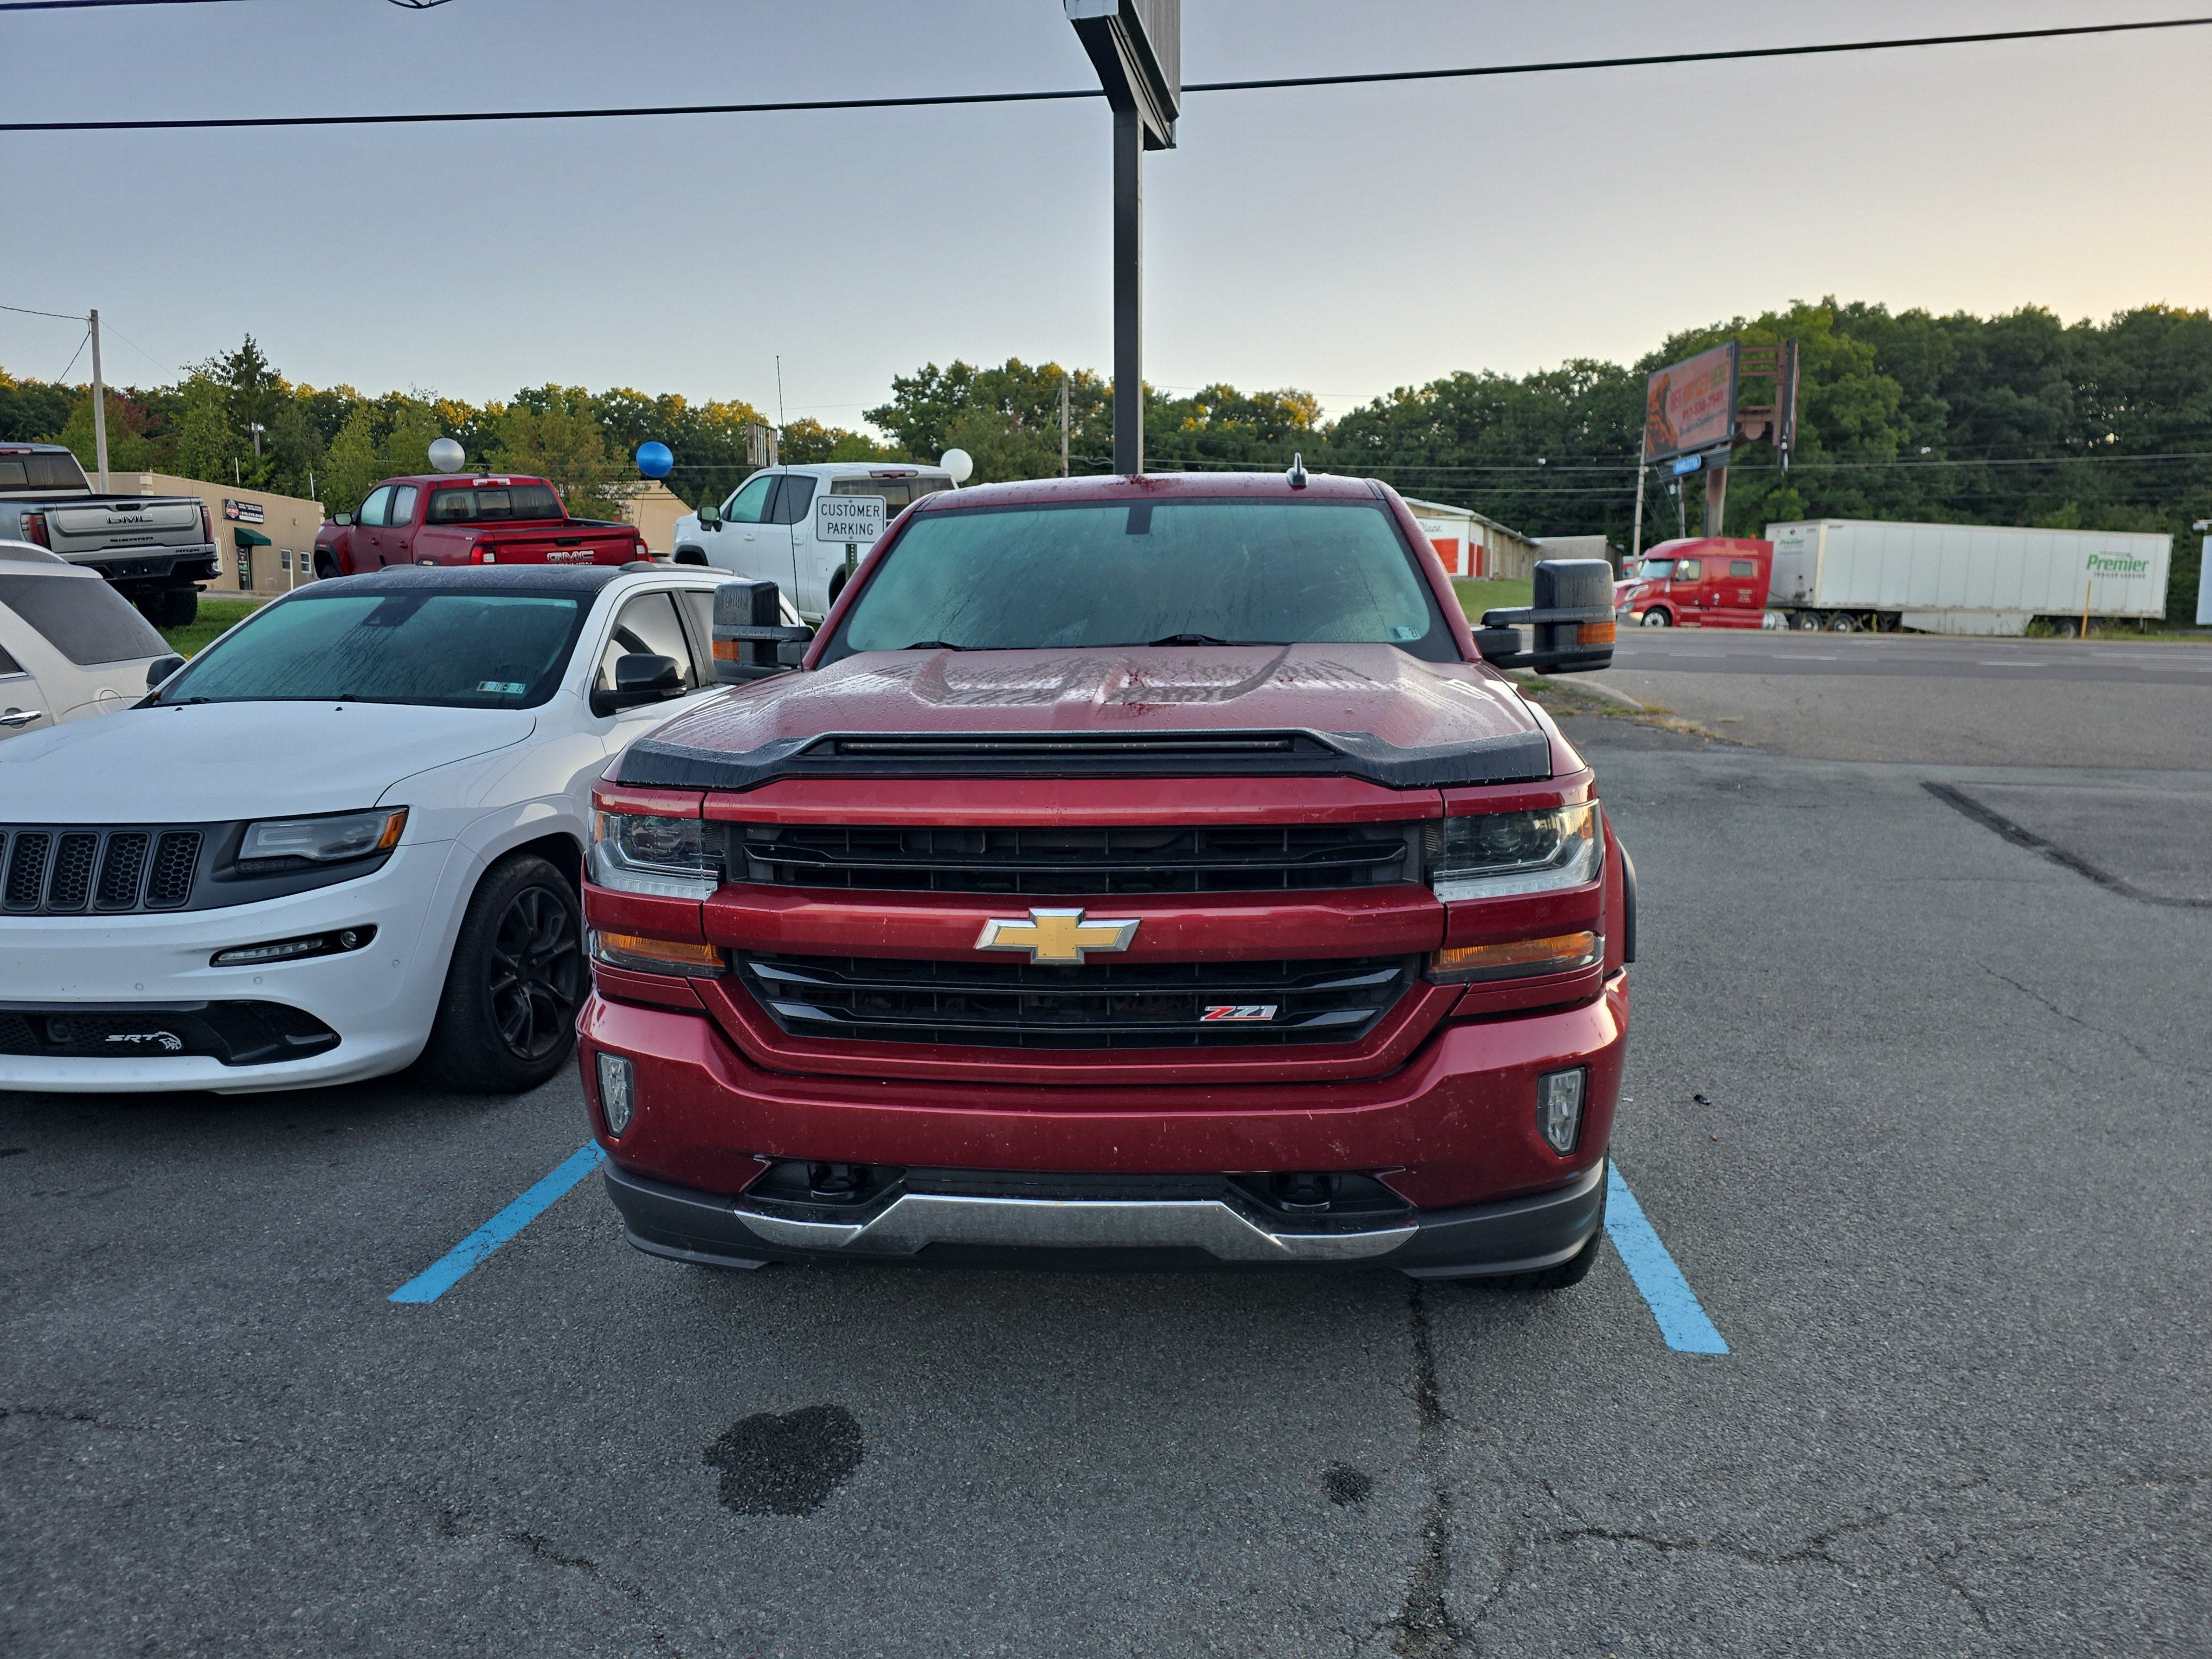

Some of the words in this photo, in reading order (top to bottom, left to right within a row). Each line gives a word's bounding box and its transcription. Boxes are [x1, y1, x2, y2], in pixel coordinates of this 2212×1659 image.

[821, 504, 879, 517] CUSTOMER
[107, 513, 153, 524] GMC
[827, 522, 873, 535] PARKING
[546, 550, 595, 562] GMC
[2086, 554, 2149, 571] Premier
[1199, 1005, 1278, 1021] Z71
[105, 1034, 159, 1043] SRT
